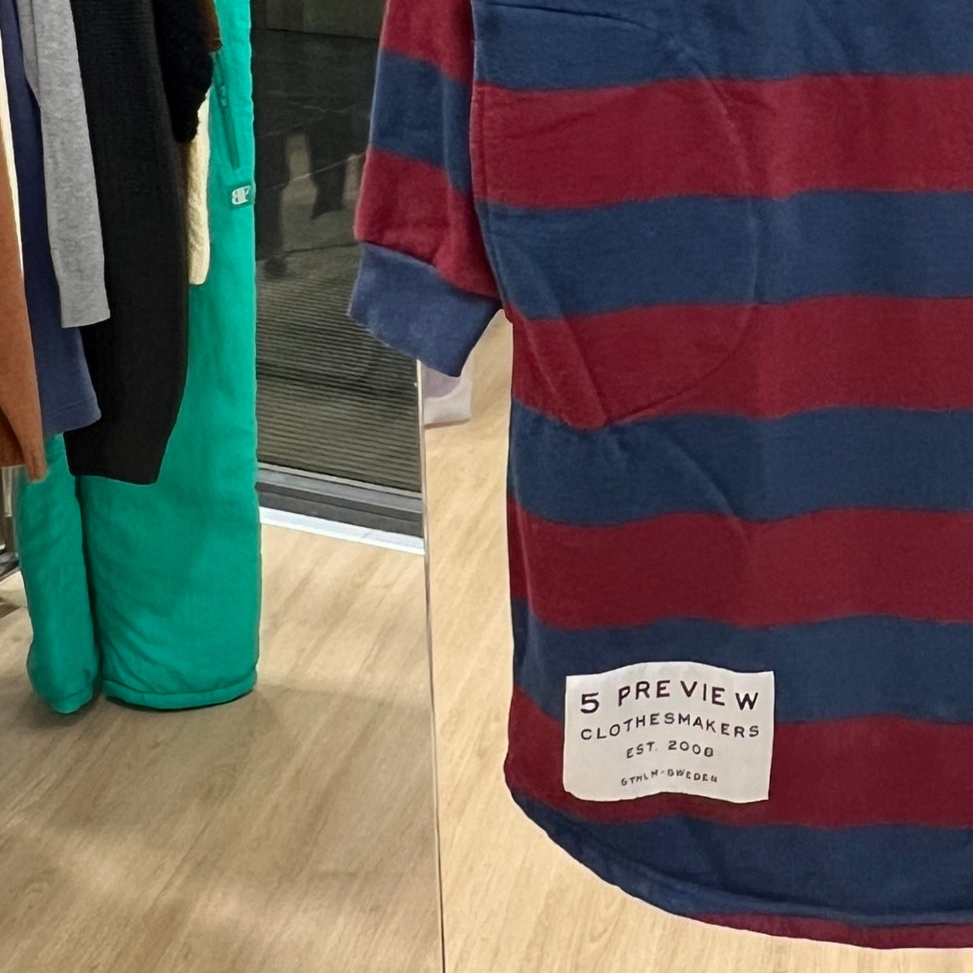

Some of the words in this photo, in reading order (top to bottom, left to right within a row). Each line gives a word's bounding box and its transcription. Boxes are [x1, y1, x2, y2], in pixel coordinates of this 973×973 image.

[580, 692, 600, 714] 5
[618, 679, 759, 711] PREVIEW
[580, 712, 760, 741] CLOTHESMAKERS
